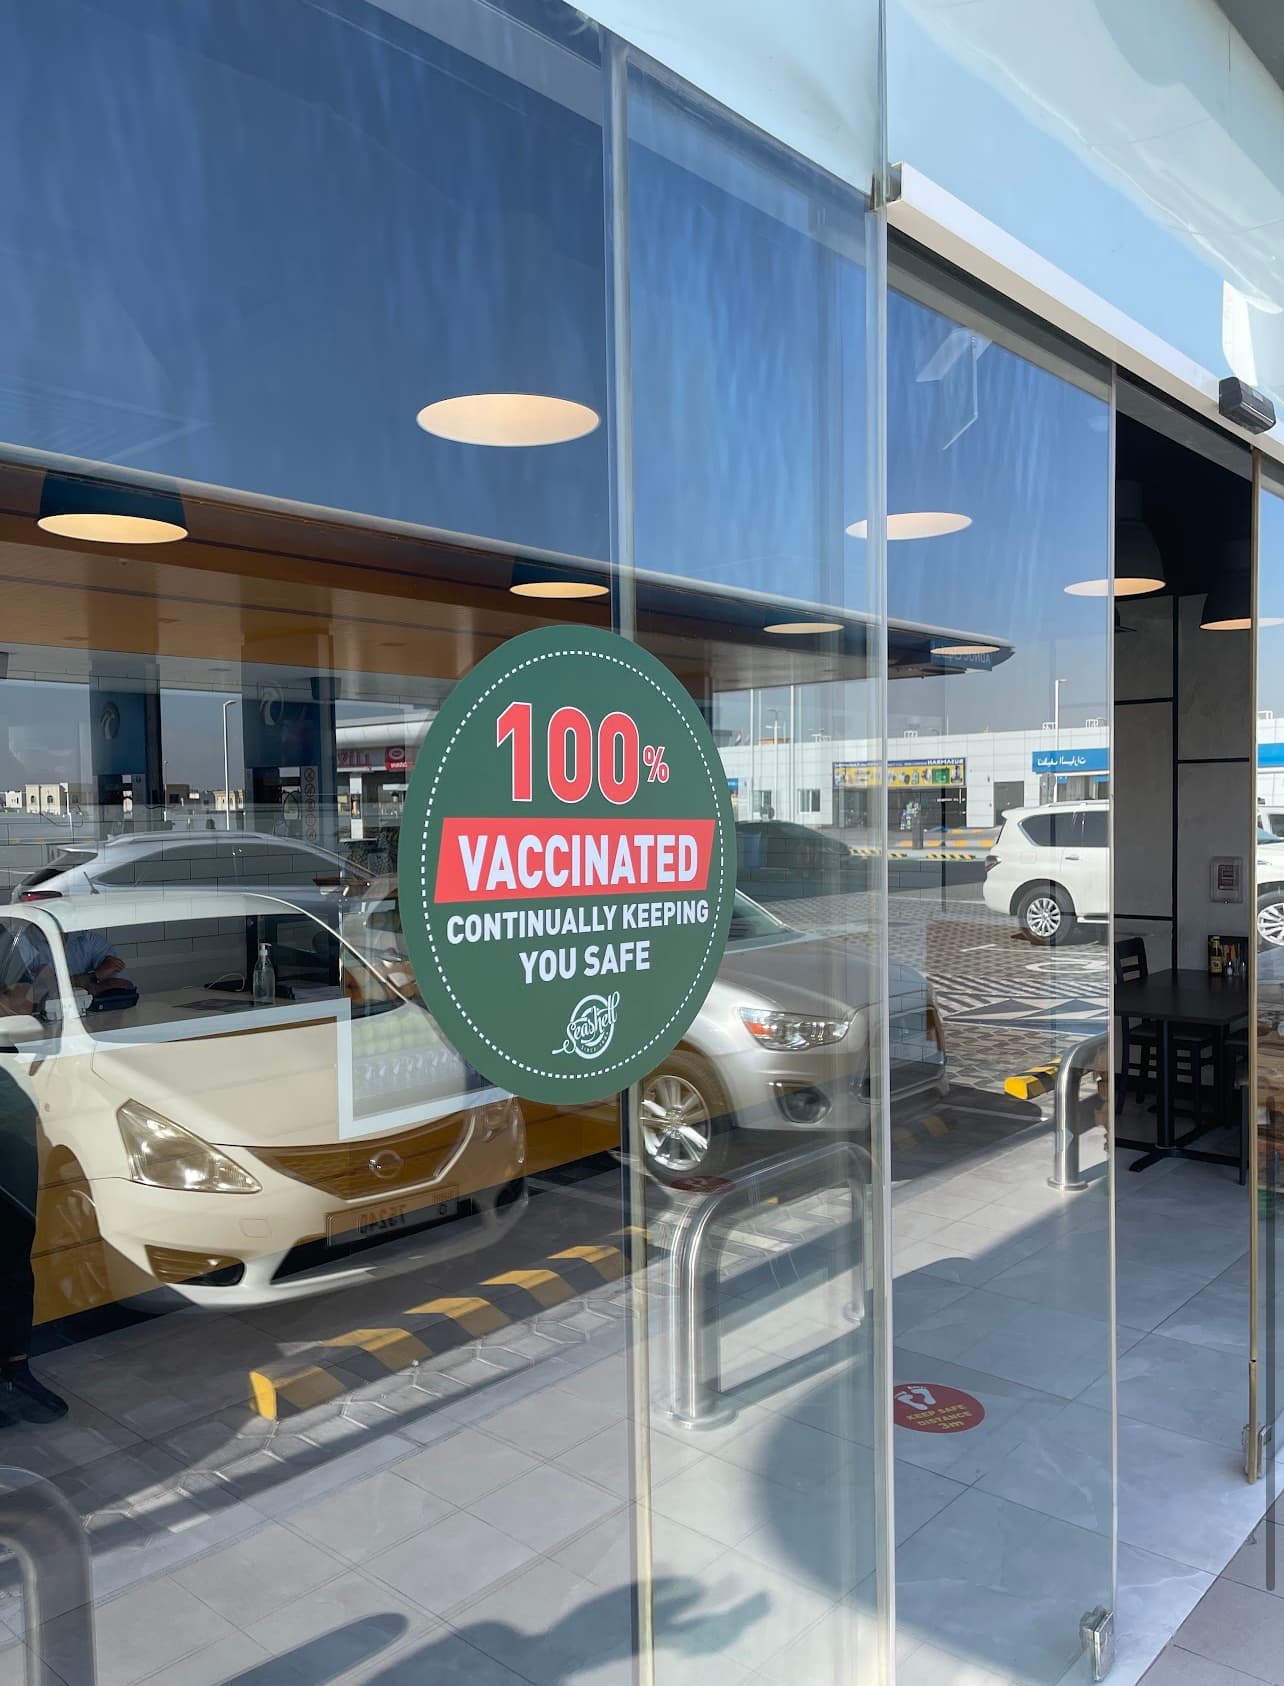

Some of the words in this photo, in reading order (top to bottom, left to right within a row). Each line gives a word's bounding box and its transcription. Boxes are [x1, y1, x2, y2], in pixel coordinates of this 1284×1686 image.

[497, 702, 669, 804] 100%
[457, 834, 698, 892] VACCINATED
[446, 904, 616, 945] CONTINUALLY
[622, 899, 709, 930] KEEPING
[518, 945, 577, 985] YOU
[583, 940, 651, 977] SAFE
[552, 991, 620, 1054] Seashell
[906, 1410, 936, 1420] KEEP
[937, 1404, 967, 1414] SAFE
[918, 1411, 973, 1426] DISTANCE
